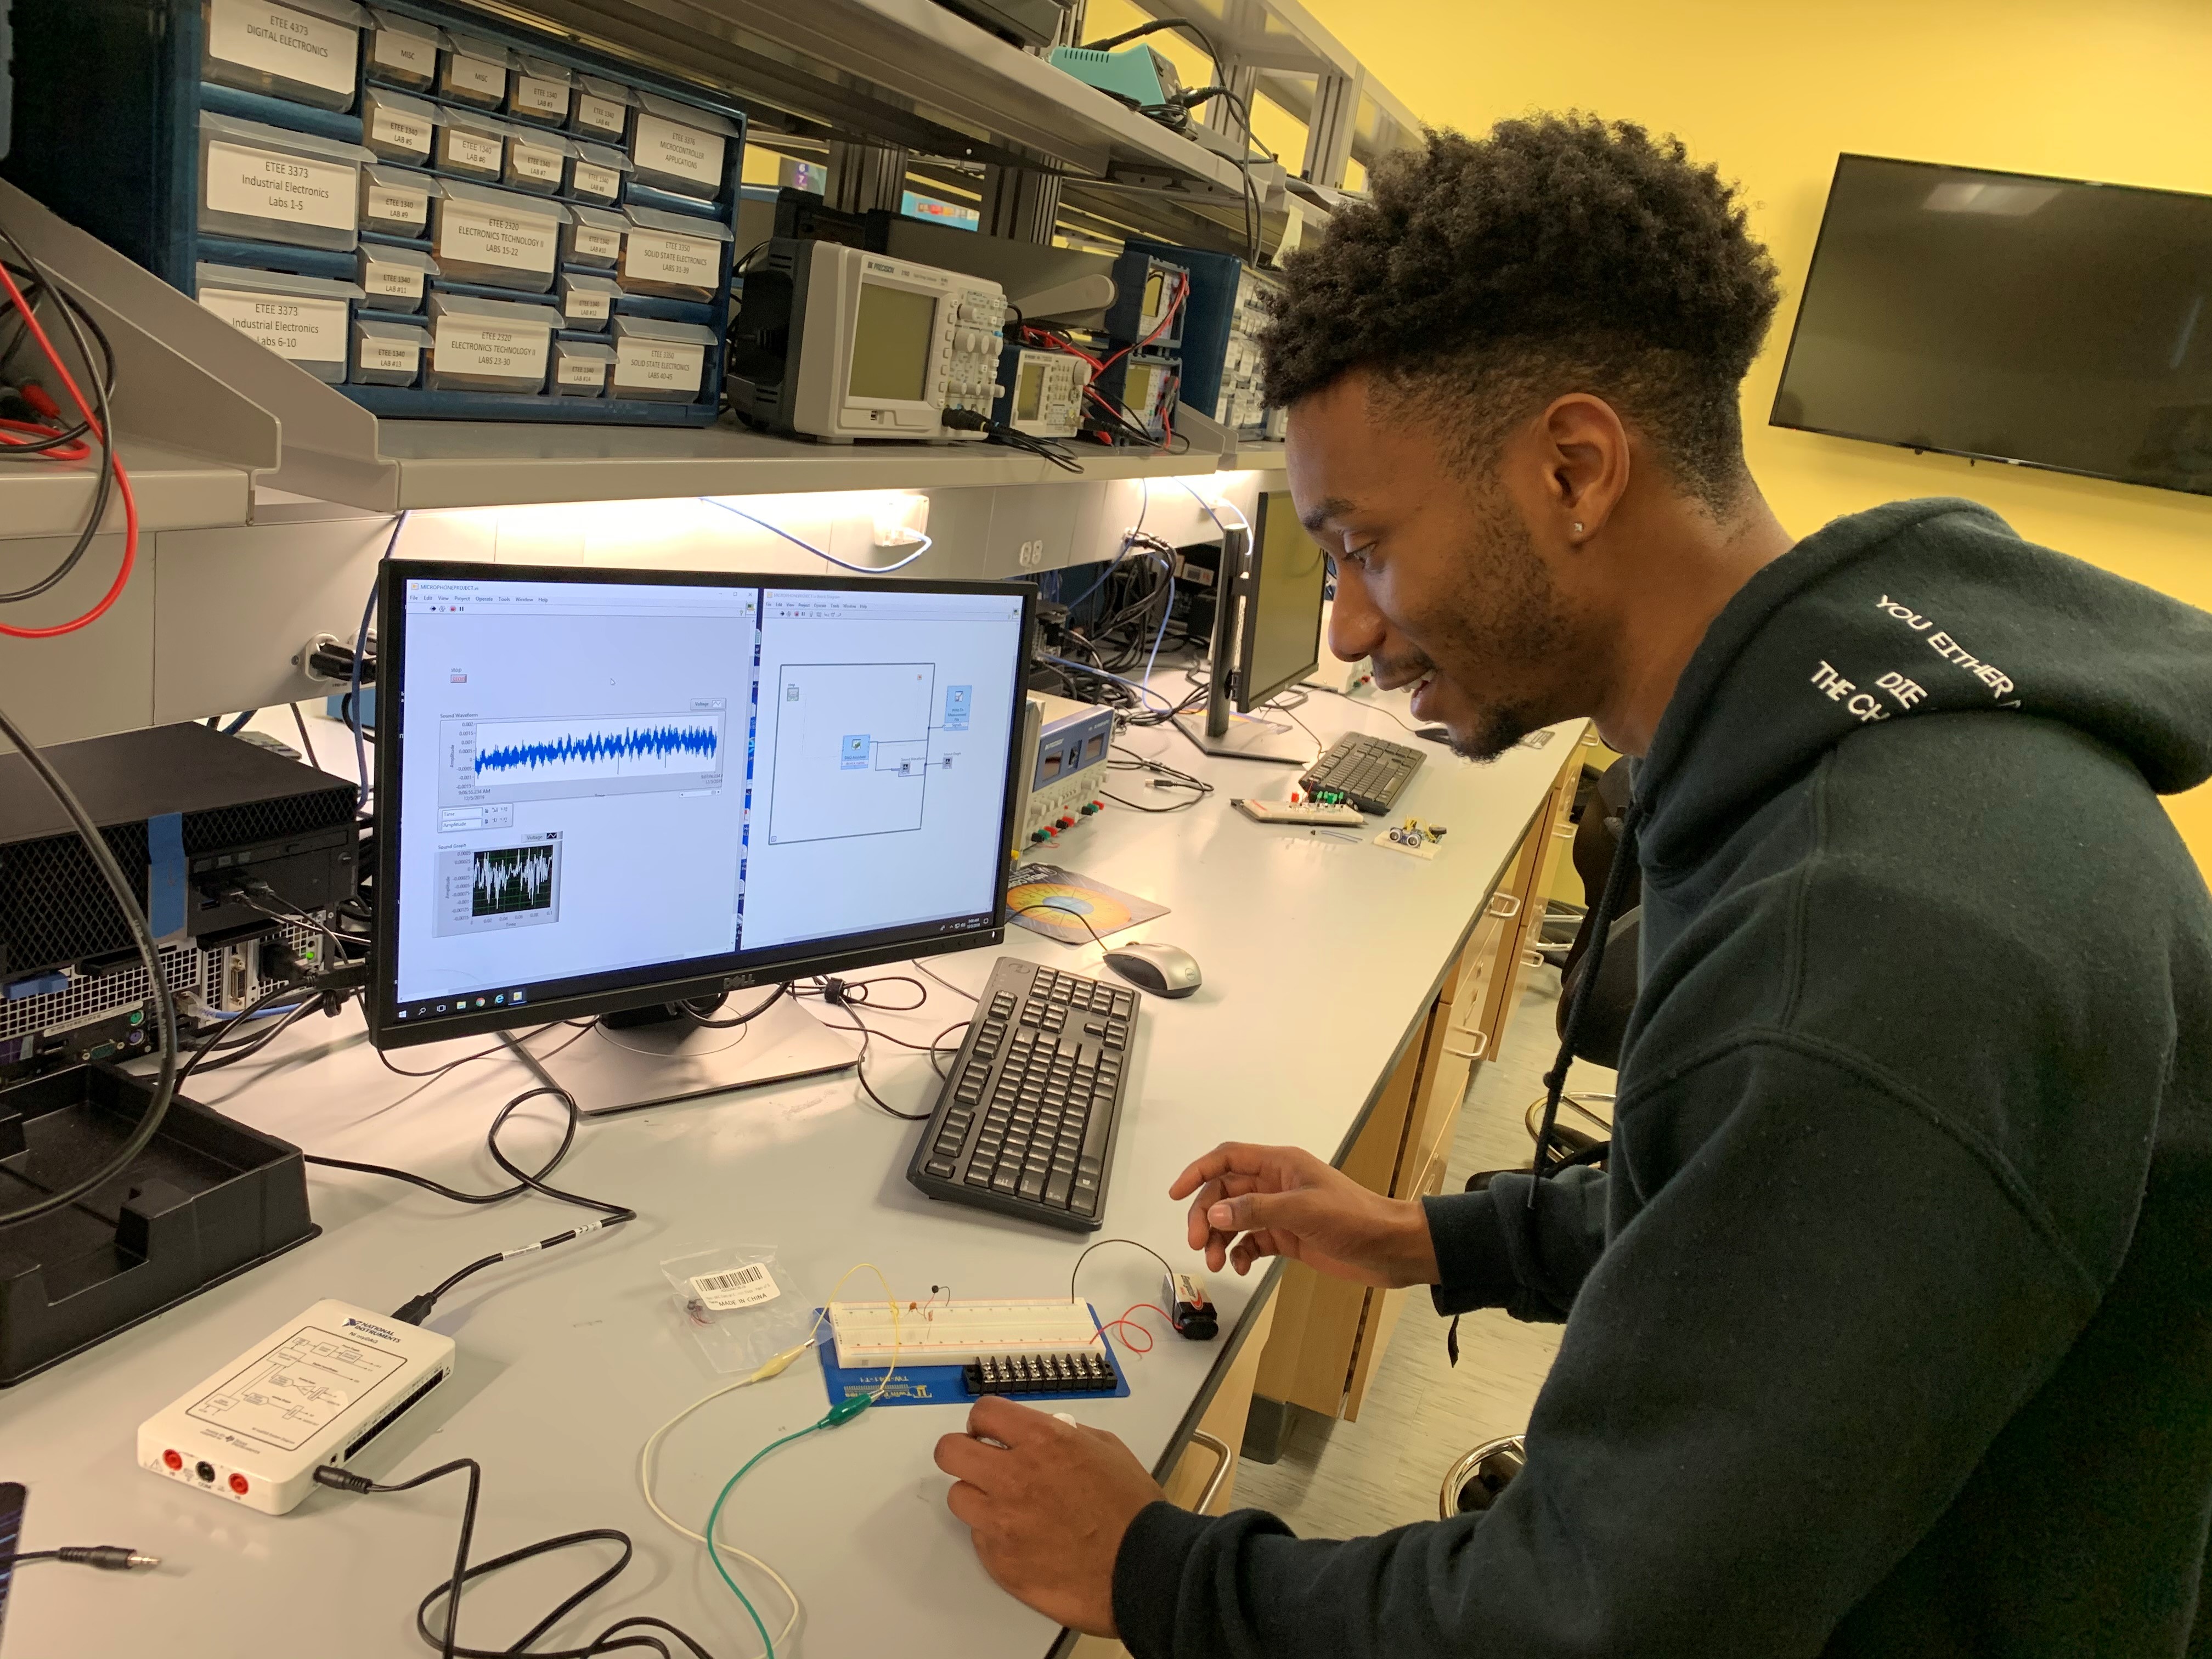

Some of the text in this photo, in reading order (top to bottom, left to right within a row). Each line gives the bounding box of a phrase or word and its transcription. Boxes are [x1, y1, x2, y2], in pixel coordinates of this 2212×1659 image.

[270, 15, 308, 35] ETEE 4373
[247, 24, 328, 58] DIGITAL ELECTRONICS
[401, 49, 415, 60] MISC
[475, 73, 488, 83] MISC
[391, 122, 418, 136] ETEE 1340
[394, 135, 405, 144] LAB
[462, 141, 492, 154] ETEE 1340
[660, 140, 704, 160] MICROCONTROLLER
[466, 153, 486, 163] LAB #6
[665, 154, 697, 170] APPLICATIONS
[266, 161, 309, 178] ETEE 3373
[242, 174, 329, 199] Industrial Electronics
[269, 196, 303, 211] Labs 1-5
[386, 198, 414, 208] ETEE 1340
[489, 218, 520, 231] ETEE 2320
[459, 226, 500, 240] ELECTRONICS
[501, 233, 540, 247] TECHNOLOGY
[486, 244, 518, 256] LABS 15-22
[644, 249, 707, 266] SOLID STATE ELECTRONICS
[663, 264, 689, 274] LABS 31-39
[874, 263, 895, 274] PRECISION
[255, 303, 298, 316] ETEE 3373
[233, 318, 319, 334] Industrial Electronics
[278, 337, 296, 347] 6-10
[482, 331, 512, 342] ETEE 2320
[452, 341, 492, 352] ELECTRONICS
[494, 345, 532, 356] TECHNOLOGY
[478, 356, 510, 366] LABS 23-30
[661, 362, 690, 371] ELECTRONICS
[1876, 594, 2014, 699] YOU EITHER
[1810, 660, 1856, 702] THE
[1875, 671, 1928, 710] DIE
[724, 973, 755, 989] DELL
[747, 1293, 767, 1302] CHINA
[354, 1325, 402, 1343] INSTRUMENTS
[362, 1322, 394, 1336] NATIONAL
